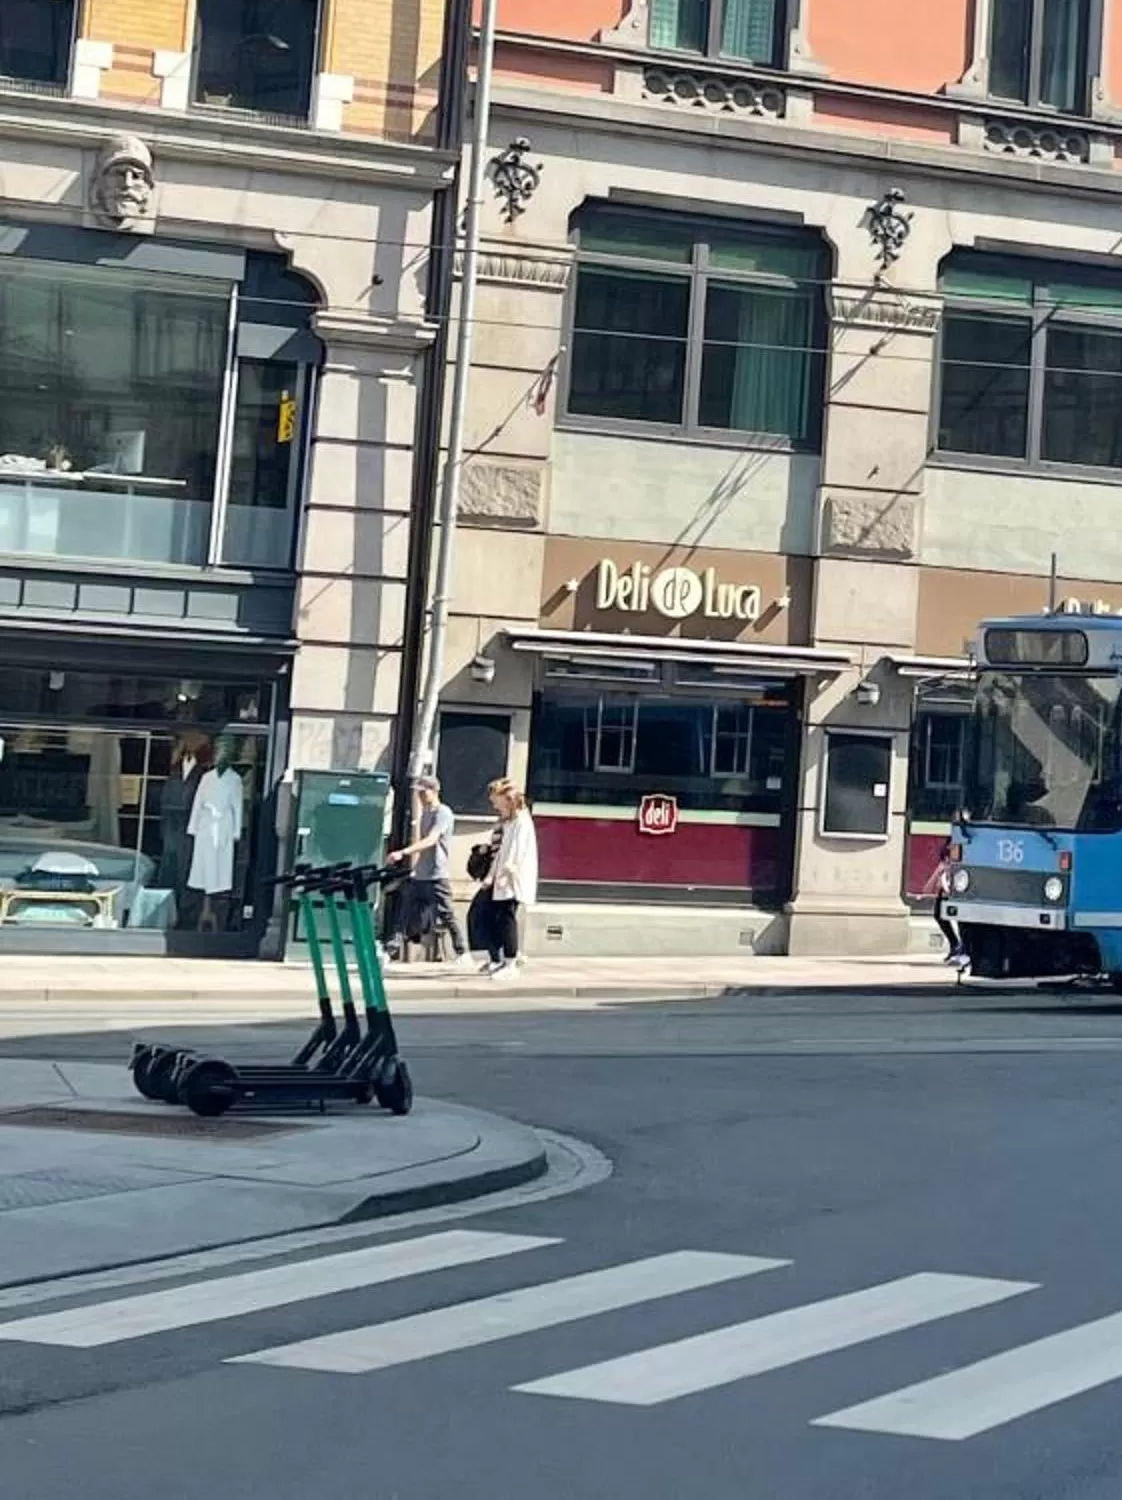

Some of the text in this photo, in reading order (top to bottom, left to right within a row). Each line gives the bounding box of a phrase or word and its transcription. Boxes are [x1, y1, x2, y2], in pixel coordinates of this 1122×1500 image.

[596, 558, 761, 620] Deli de Luca
[645, 800, 670, 825] deli
[997, 839, 1025, 863] 136
